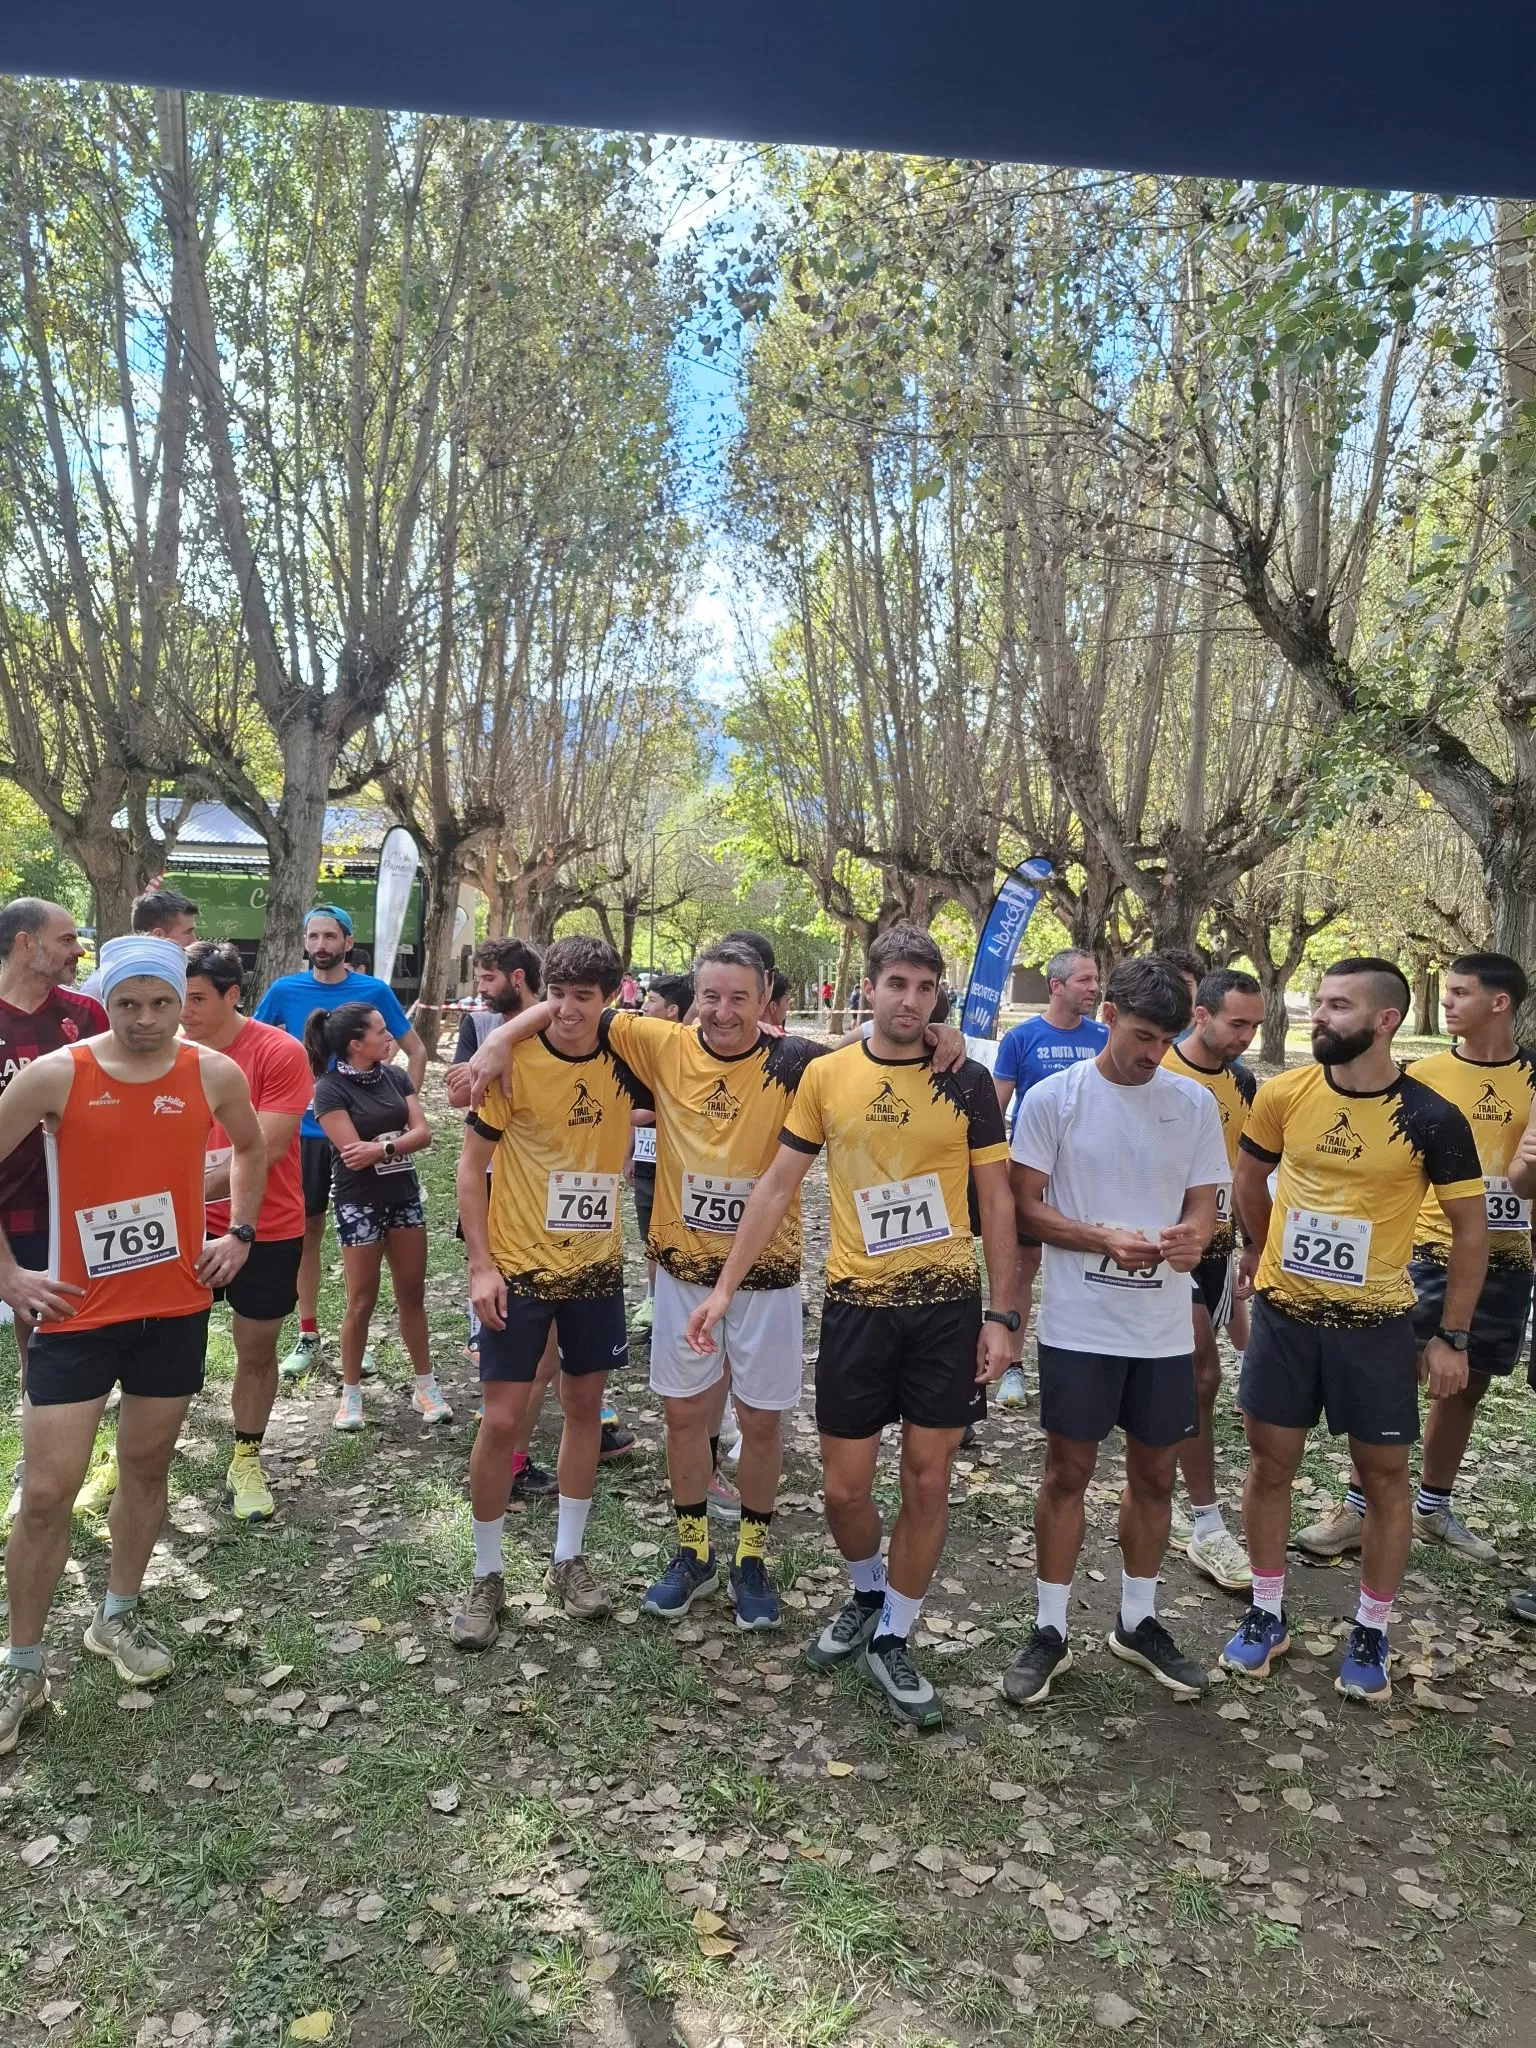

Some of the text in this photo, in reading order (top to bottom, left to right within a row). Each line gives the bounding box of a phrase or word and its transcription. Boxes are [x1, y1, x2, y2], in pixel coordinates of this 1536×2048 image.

[1037, 1047, 1050, 1059] 32
[1051, 1046, 1074, 1058] RUTA
[573, 1106, 590, 1117] TRAIL
[707, 1101, 727, 1111] TRAIL
[873, 1103, 894, 1114] TRAIL
[1478, 1104, 1498, 1113] TRAIL
[865, 1114, 899, 1122] GALLINERO
[1472, 1113, 1502, 1121] GALLINERO
[638, 1140, 656, 1155] 740
[1325, 1134, 1347, 1148] TRAIL
[1315, 1144, 1351, 1157] GALLINERO
[558, 1194, 608, 1221] 764
[691, 1193, 746, 1223] 750
[1488, 1196, 1520, 1220] 39
[870, 1200, 933, 1240] 771
[94, 1220, 165, 1261] 769
[1292, 1233, 1355, 1270] 526
